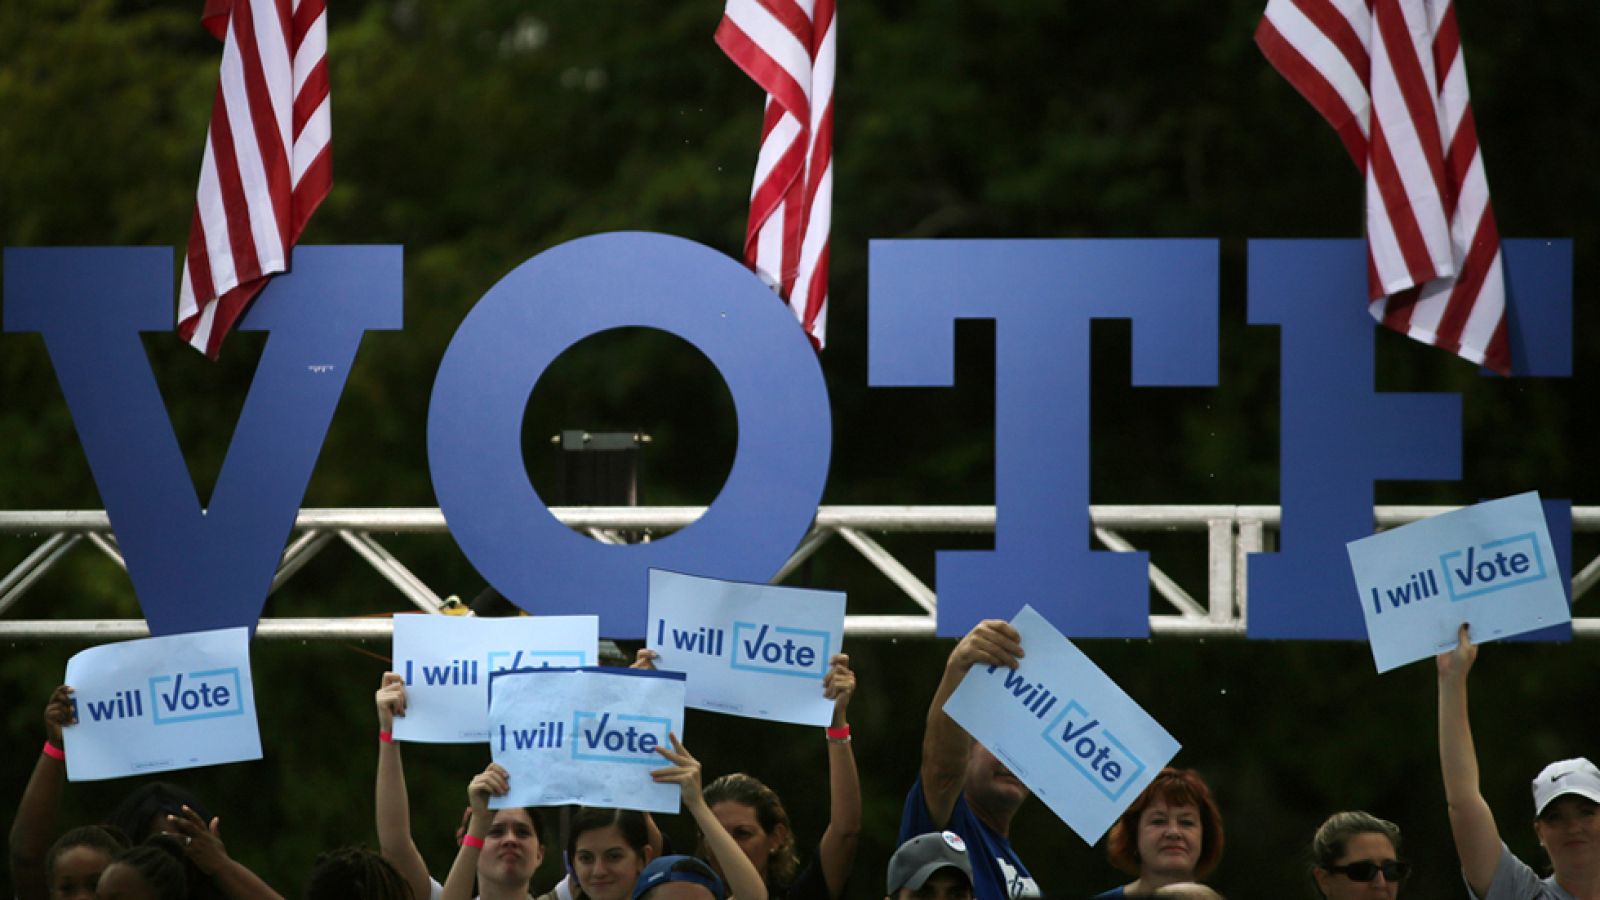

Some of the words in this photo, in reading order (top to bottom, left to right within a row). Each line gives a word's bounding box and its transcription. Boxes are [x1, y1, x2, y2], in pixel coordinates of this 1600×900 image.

[4, 231, 1573, 641] VOTE
[1371, 587, 1382, 614] I
[1386, 569, 1440, 608] will
[657, 619, 665, 646] I
[672, 627, 724, 656] will
[405, 660, 413, 686] I
[422, 659, 478, 686] will
[87, 689, 143, 721] will
[1004, 668, 1058, 720] will
[499, 724, 507, 752] I
[512, 721, 564, 750] will
